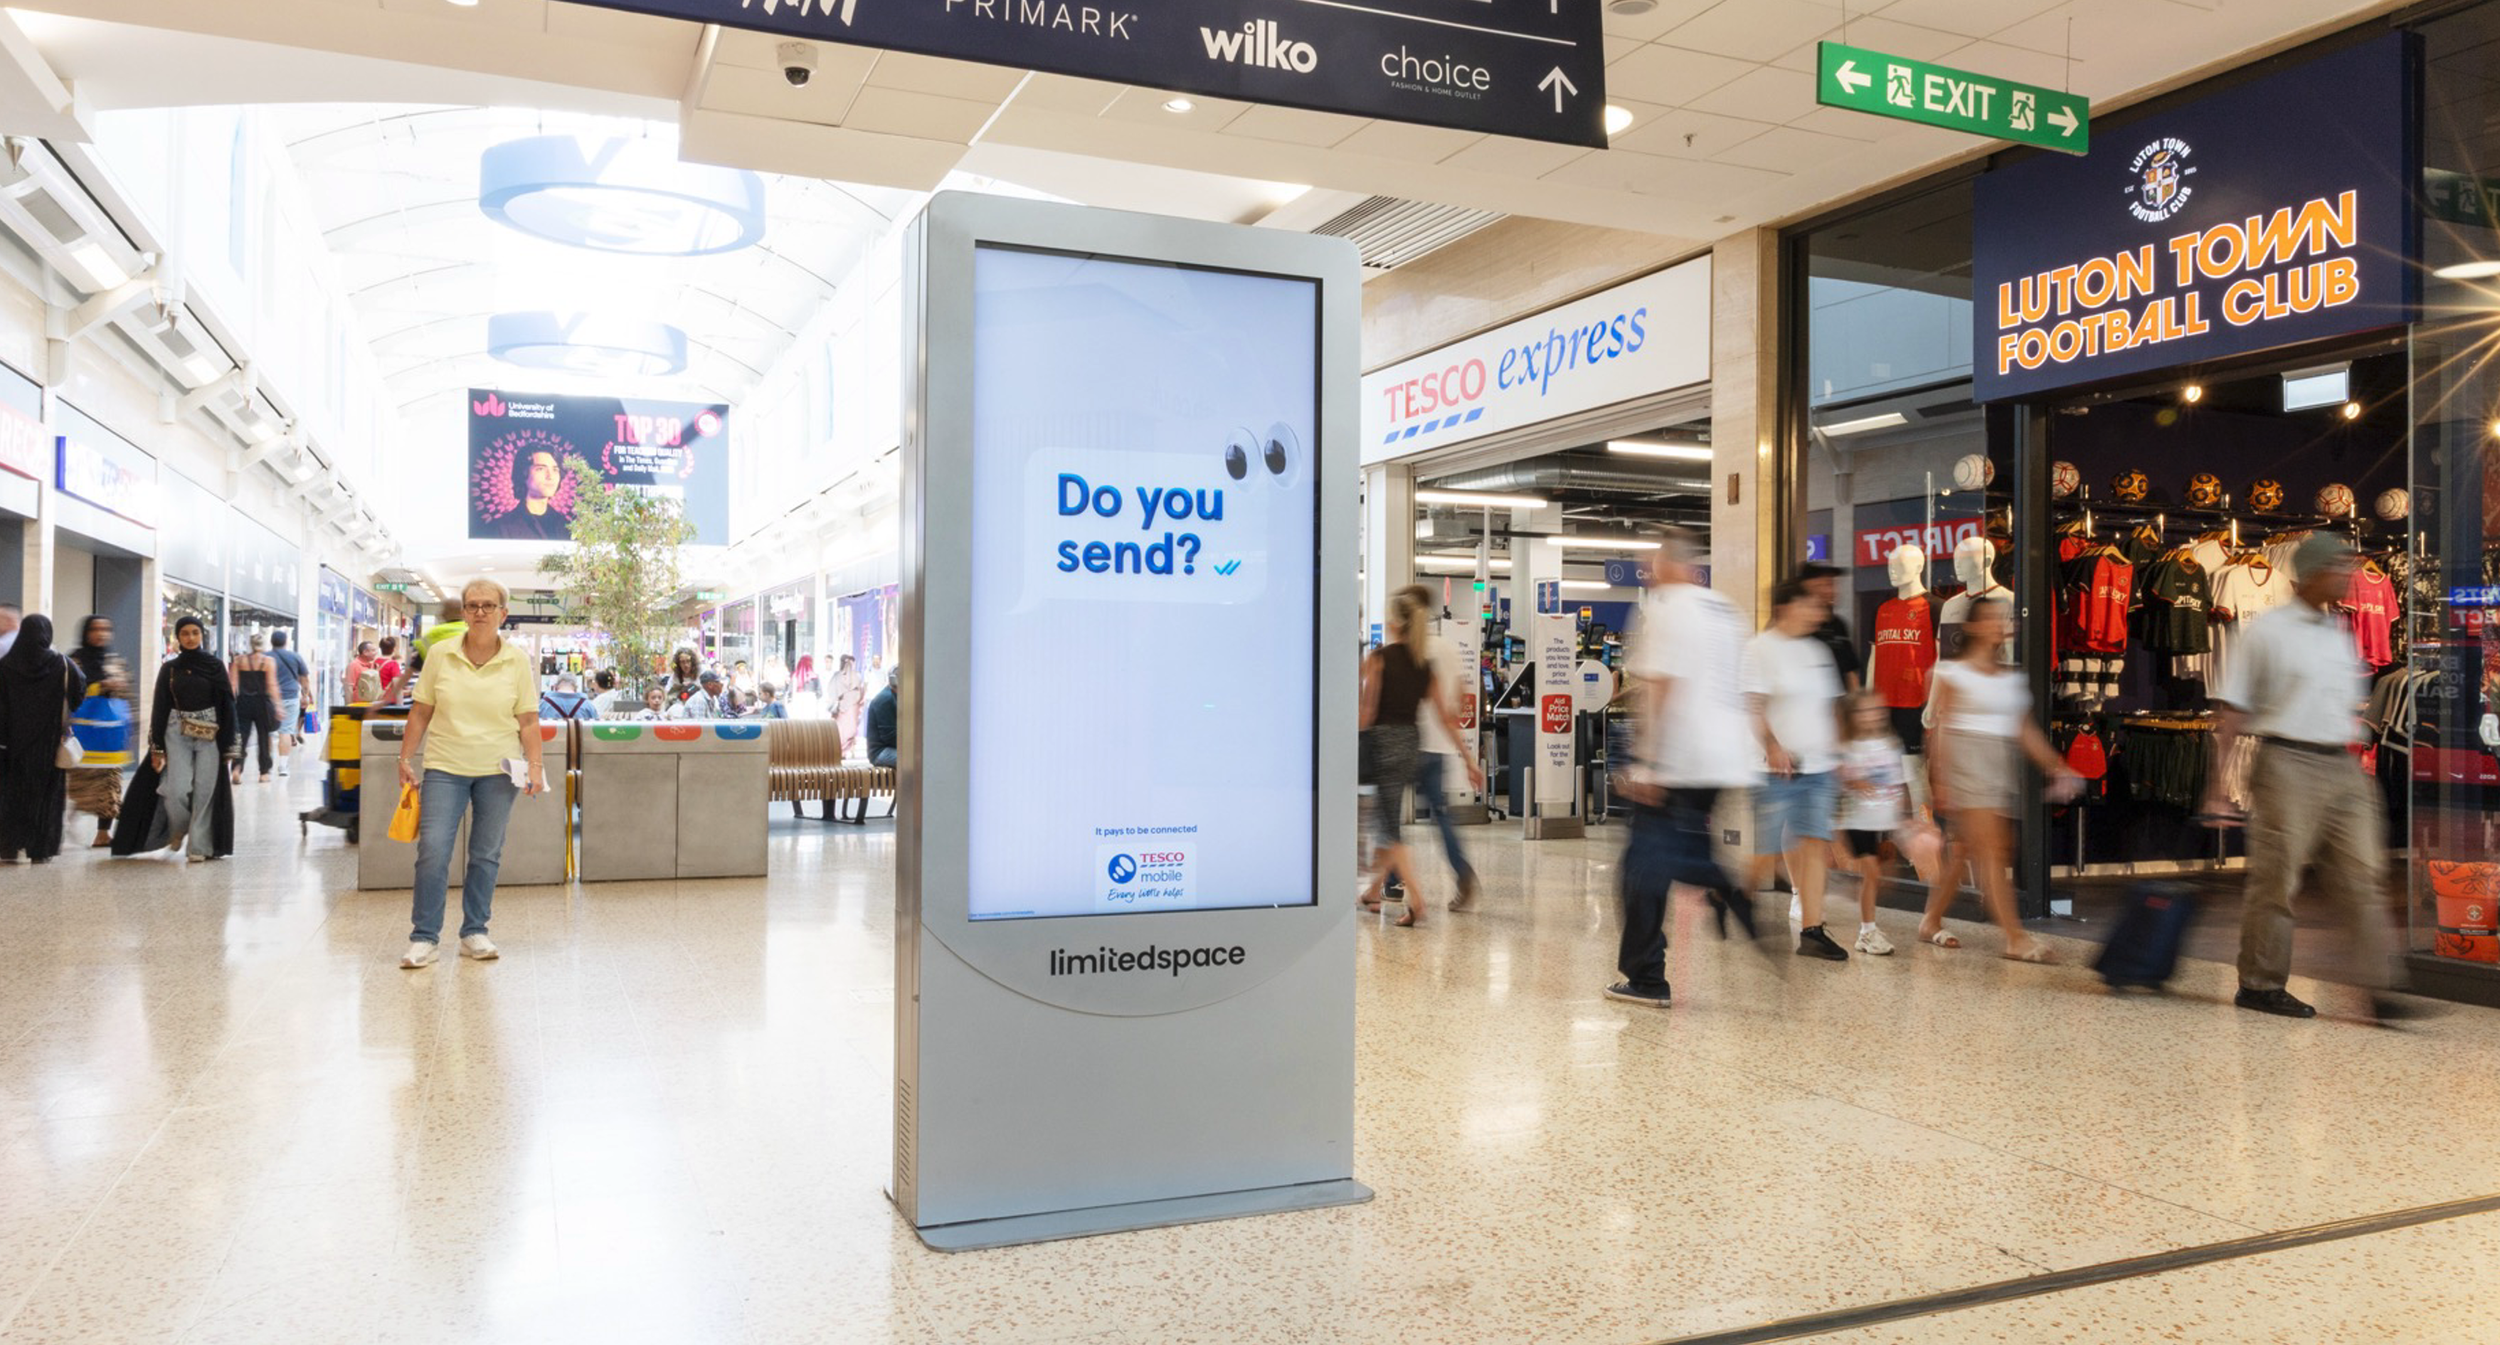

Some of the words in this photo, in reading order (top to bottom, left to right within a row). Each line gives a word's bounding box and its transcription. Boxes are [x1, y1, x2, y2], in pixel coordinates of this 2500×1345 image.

[1200, 19, 1318, 73] wilko
[1381, 45, 1490, 90] choice
[1391, 81, 1423, 92] FASHION
[1432, 88, 1452, 96] HOME
[1454, 90, 1482, 100] OUTLET
[1924, 74, 1996, 121] EXIT
[2129, 140, 2160, 173] LUTON
[2162, 138, 2191, 158] TOWN
[2129, 201, 2171, 222] FOOTBALL
[2170, 186, 2192, 213] CLUB
[1999, 244, 2155, 329] LUTON
[2169, 190, 2357, 288] TOWN
[1999, 293, 2209, 375] FOOTBALL
[2222, 257, 2360, 327] CLUB
[1383, 358, 1487, 423] TESCO
[1497, 307, 1648, 397] express
[508, 402, 545, 413] University
[508, 410, 555, 419] Bedfordshire
[613, 414, 653, 444] TOP
[655, 417, 682, 446] 30
[614, 445, 626, 455] FOR
[657, 448, 682, 458] QUALITY
[1058, 473, 1123, 518] Do
[1136, 486, 1223, 530] you
[1057, 532, 1202, 575] send?
[1877, 629, 1901, 641] CAPITAL
[1903, 629, 1922, 641] SKY
[1547, 712, 1570, 721] Match
[1549, 704, 1569, 712] Price
[1096, 828, 1102, 836] It
[1104, 828, 1124, 837] pays
[1126, 827, 1135, 835] to
[1137, 826, 1148, 835] be
[1150, 825, 1197, 834] connected
[1140, 852, 1184, 863] TESCO
[1140, 870, 1182, 882] mobile
[1107, 888, 1135, 903] Every
[1138, 888, 1160, 899] little
[1163, 887, 1184, 899] helps
[1050, 945, 1246, 977] limitedspace
